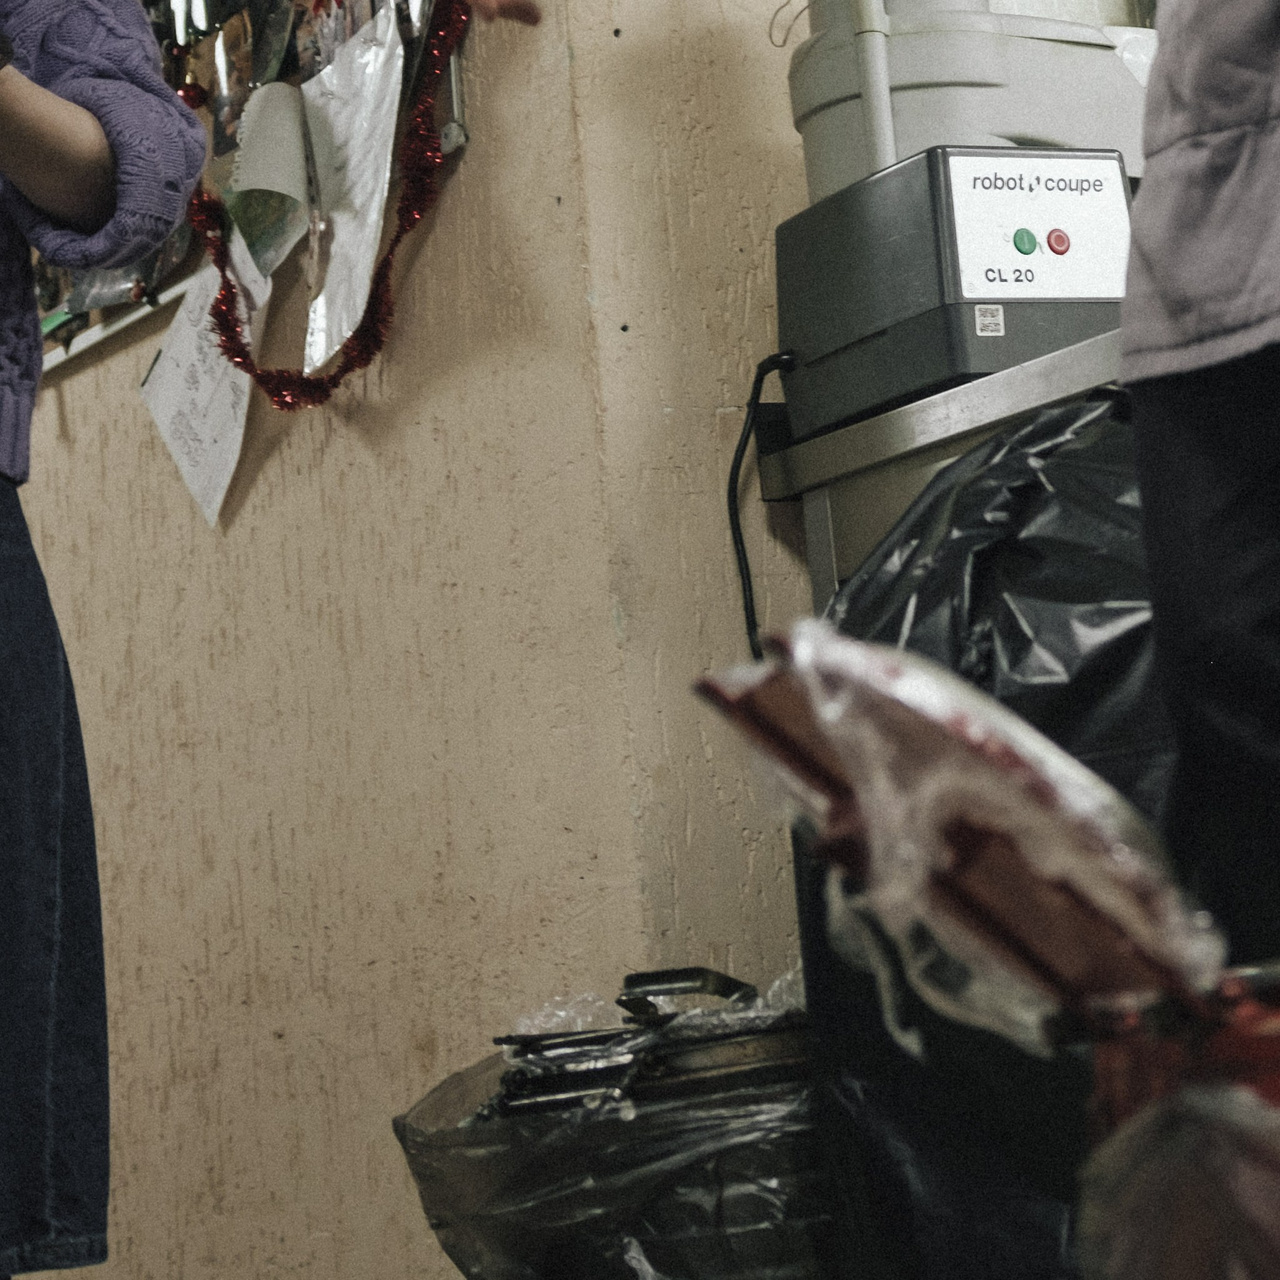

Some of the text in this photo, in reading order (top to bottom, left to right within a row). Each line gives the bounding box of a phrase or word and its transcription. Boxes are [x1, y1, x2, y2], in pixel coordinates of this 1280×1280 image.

[972, 172, 1104, 196] robot coupe
[985, 268, 1035, 283] CL 20
